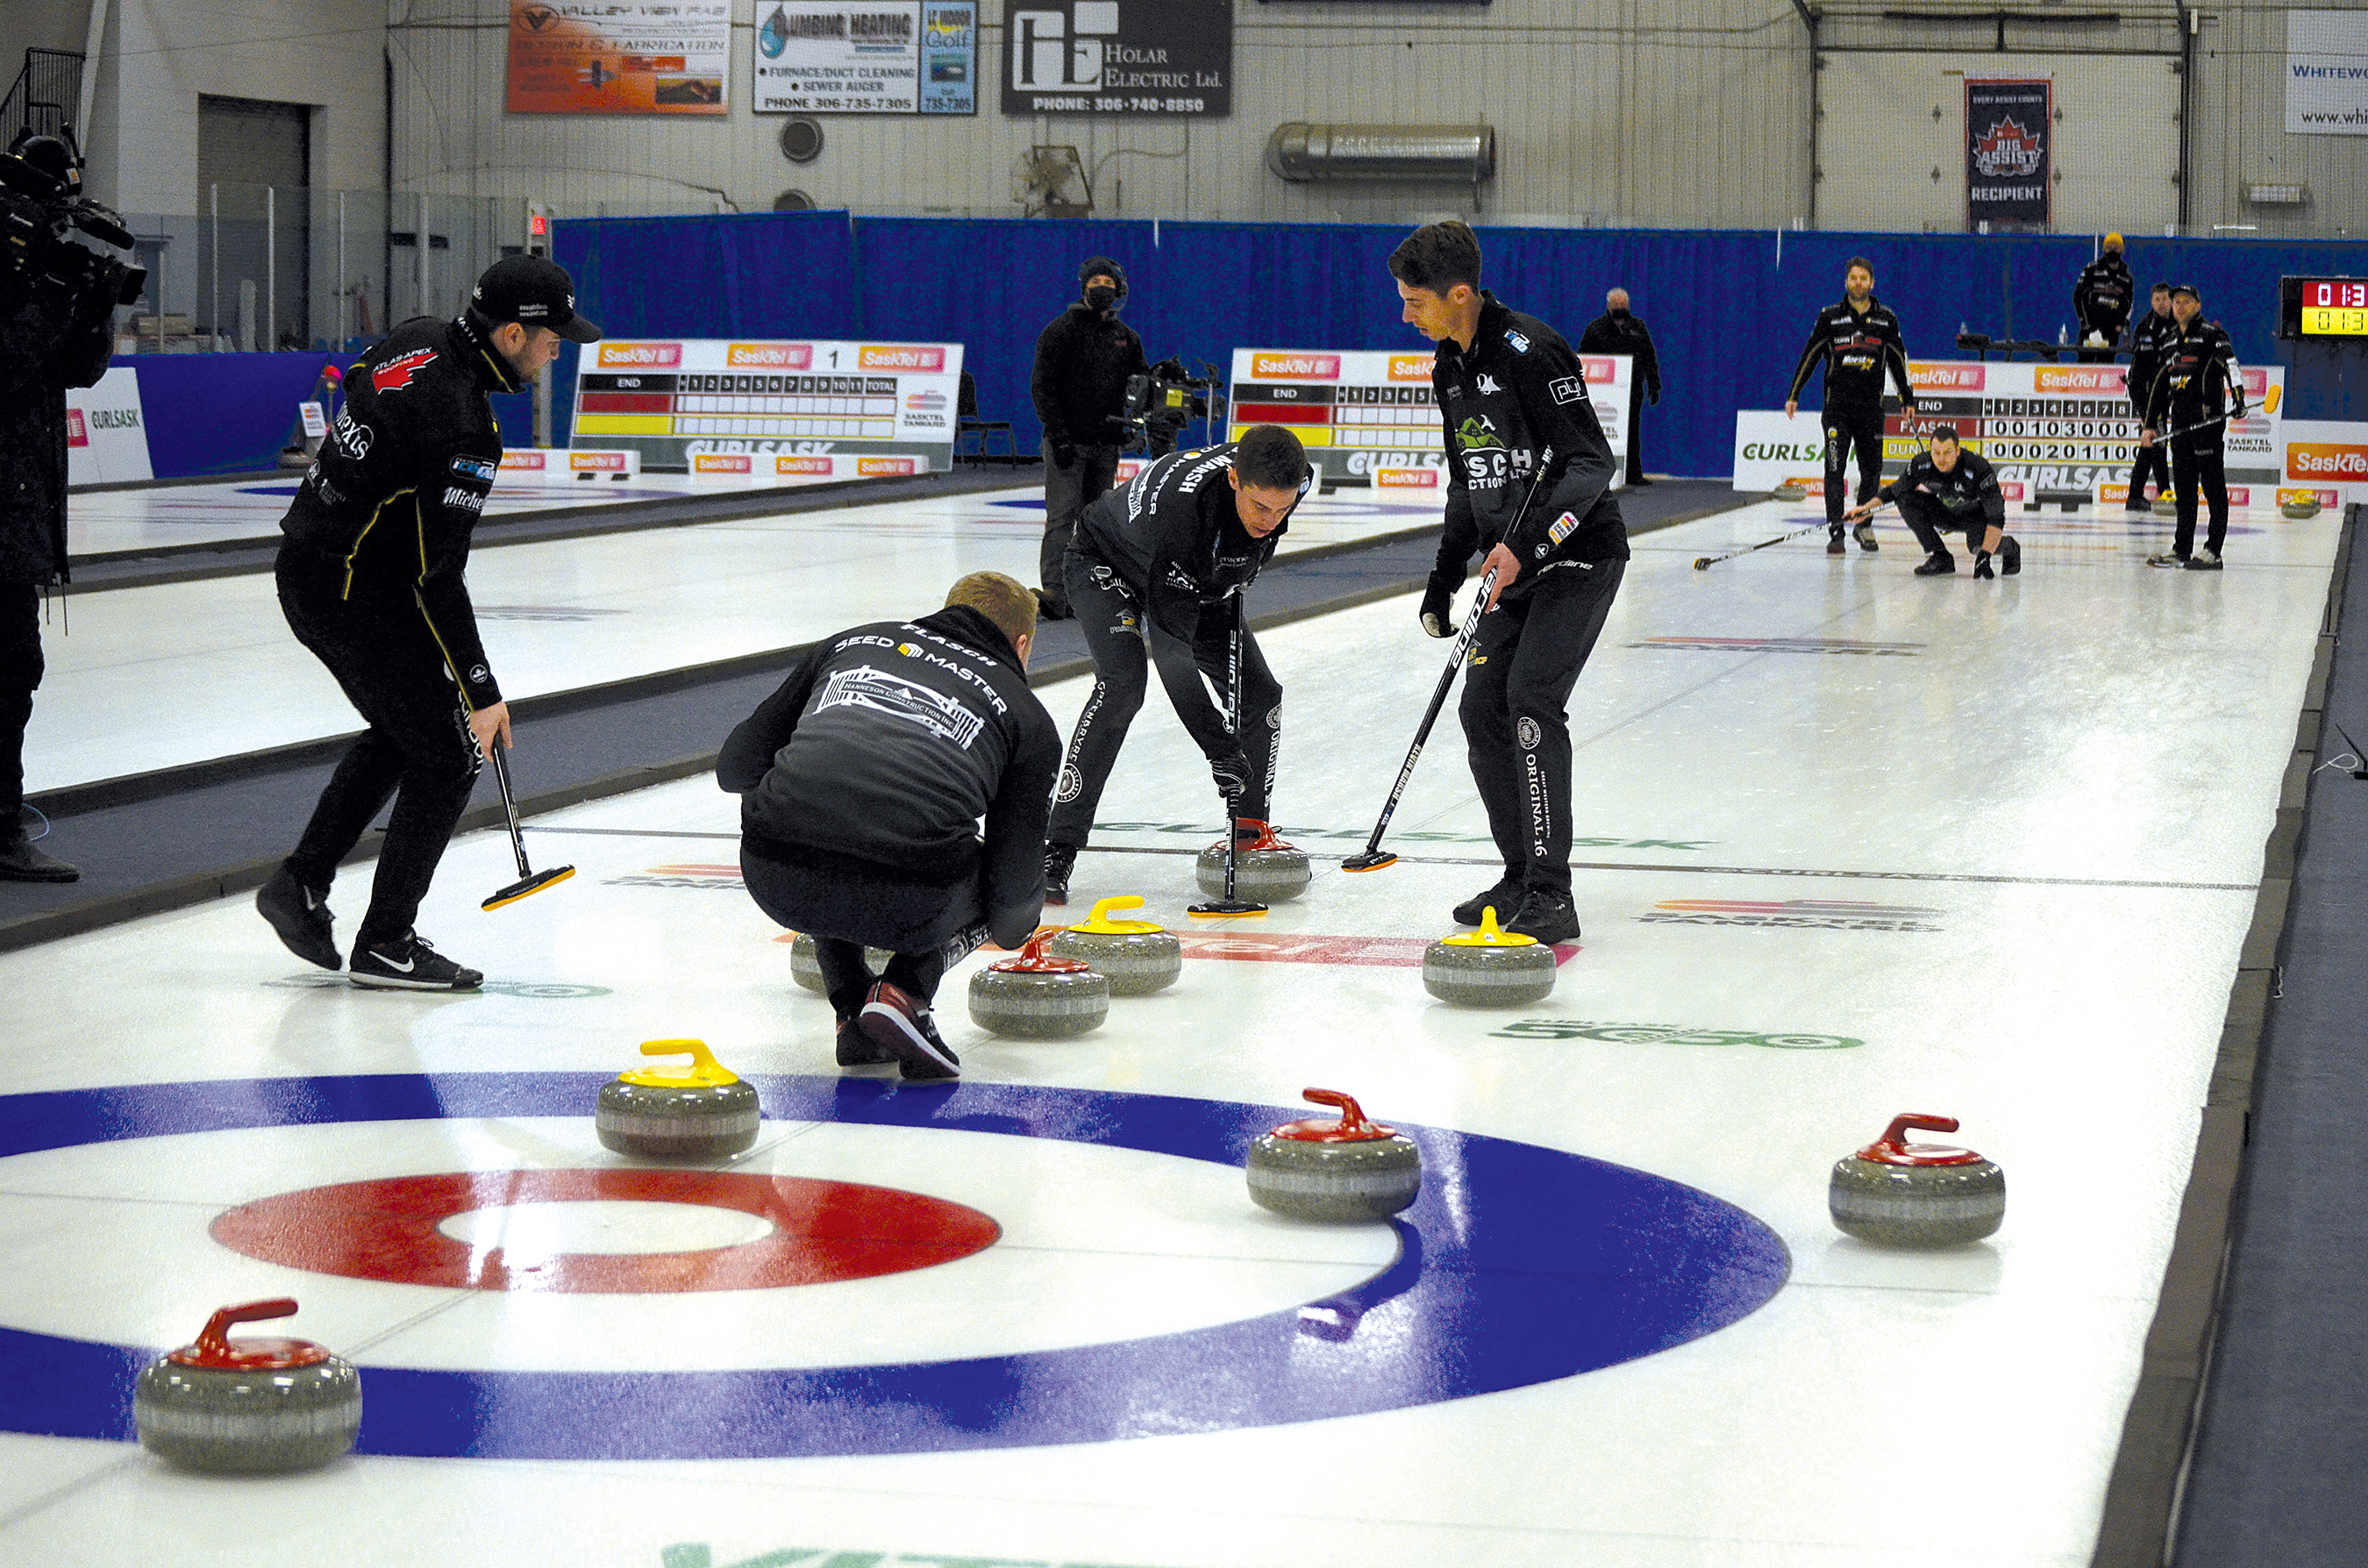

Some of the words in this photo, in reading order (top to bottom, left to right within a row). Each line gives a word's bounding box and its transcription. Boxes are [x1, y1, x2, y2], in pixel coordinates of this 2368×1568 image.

[926, 29, 973, 48] Golf
[1105, 45, 1168, 64] HOLAR
[858, 68, 915, 78] CLEANING
[1105, 67, 1189, 88] ELECTRIC
[802, 82, 843, 92] SEWER
[765, 97, 810, 109] PHONE
[814, 97, 912, 109] 306-735-7305
[1033, 98, 1090, 111] PHONE:
[1971, 186, 2043, 202] RECIPIENT
[603, 348, 657, 364] SaskTel
[731, 348, 786, 364] SaskTel
[828, 349, 838, 369] 1
[864, 351, 919, 367] SaskTel
[1257, 359, 1314, 374] SaskTel
[617, 378, 641, 388] END
[707, 379, 715, 388] 2
[724, 379, 731, 389] 3
[738, 380, 747, 389] 4
[755, 380, 763, 389] 5
[771, 380, 779, 389] 6
[788, 381, 795, 389] 7
[803, 381, 811, 390] 8
[819, 381, 827, 390] 9
[867, 381, 896, 392] TOTAL
[1911, 371, 1957, 385] askTel
[2040, 372, 2097, 388] SaskTel
[1273, 388, 1298, 399] END
[1367, 390, 1376, 401] 2
[1384, 390, 1392, 401] 3
[1401, 390, 1409, 401] 4
[1417, 391, 1425, 402] 5
[1918, 401, 1943, 411] END
[2015, 404, 2022, 413] 2
[2033, 404, 2040, 413] 3
[2050, 404, 2057, 414] 4
[2067, 404, 2074, 414] 5
[2084, 404, 2091, 414] 6
[2101, 404, 2108, 414] 7
[2118, 405, 2126, 415] 8
[1995, 421, 2007, 435] 0
[2012, 422, 2024, 436] 0
[2031, 423, 2041, 436] 1
[2046, 423, 2059, 436] 0
[2064, 423, 2076, 437] 3
[2081, 424, 2093, 437] 0
[2098, 424, 2111, 437] 0
[2115, 424, 2128, 438] 0
[1994, 443, 2007, 457] 0
[2011, 444, 2024, 458] 0
[2029, 445, 2042, 458] 0
[2046, 445, 2059, 459] 2
[2063, 445, 2076, 459] 0
[2081, 445, 2091, 459] 1
[2100, 446, 2108, 460] 1
[2115, 446, 2128, 460] 0
[1177, 453, 1233, 494] MARSH
[1451, 570, 1497, 669] ardline
[900, 623, 998, 667] FLASCH
[834, 635, 895, 653] SEED
[924, 652, 1009, 716] MASTER
[844, 681, 885, 695] HANNESON
[885, 690, 941, 722] CONSTRUCTION
[1264, 730, 1280, 793] ORIGINAL
[1525, 752, 1544, 836] ORIGINAL
[1535, 839, 1549, 858] 16
